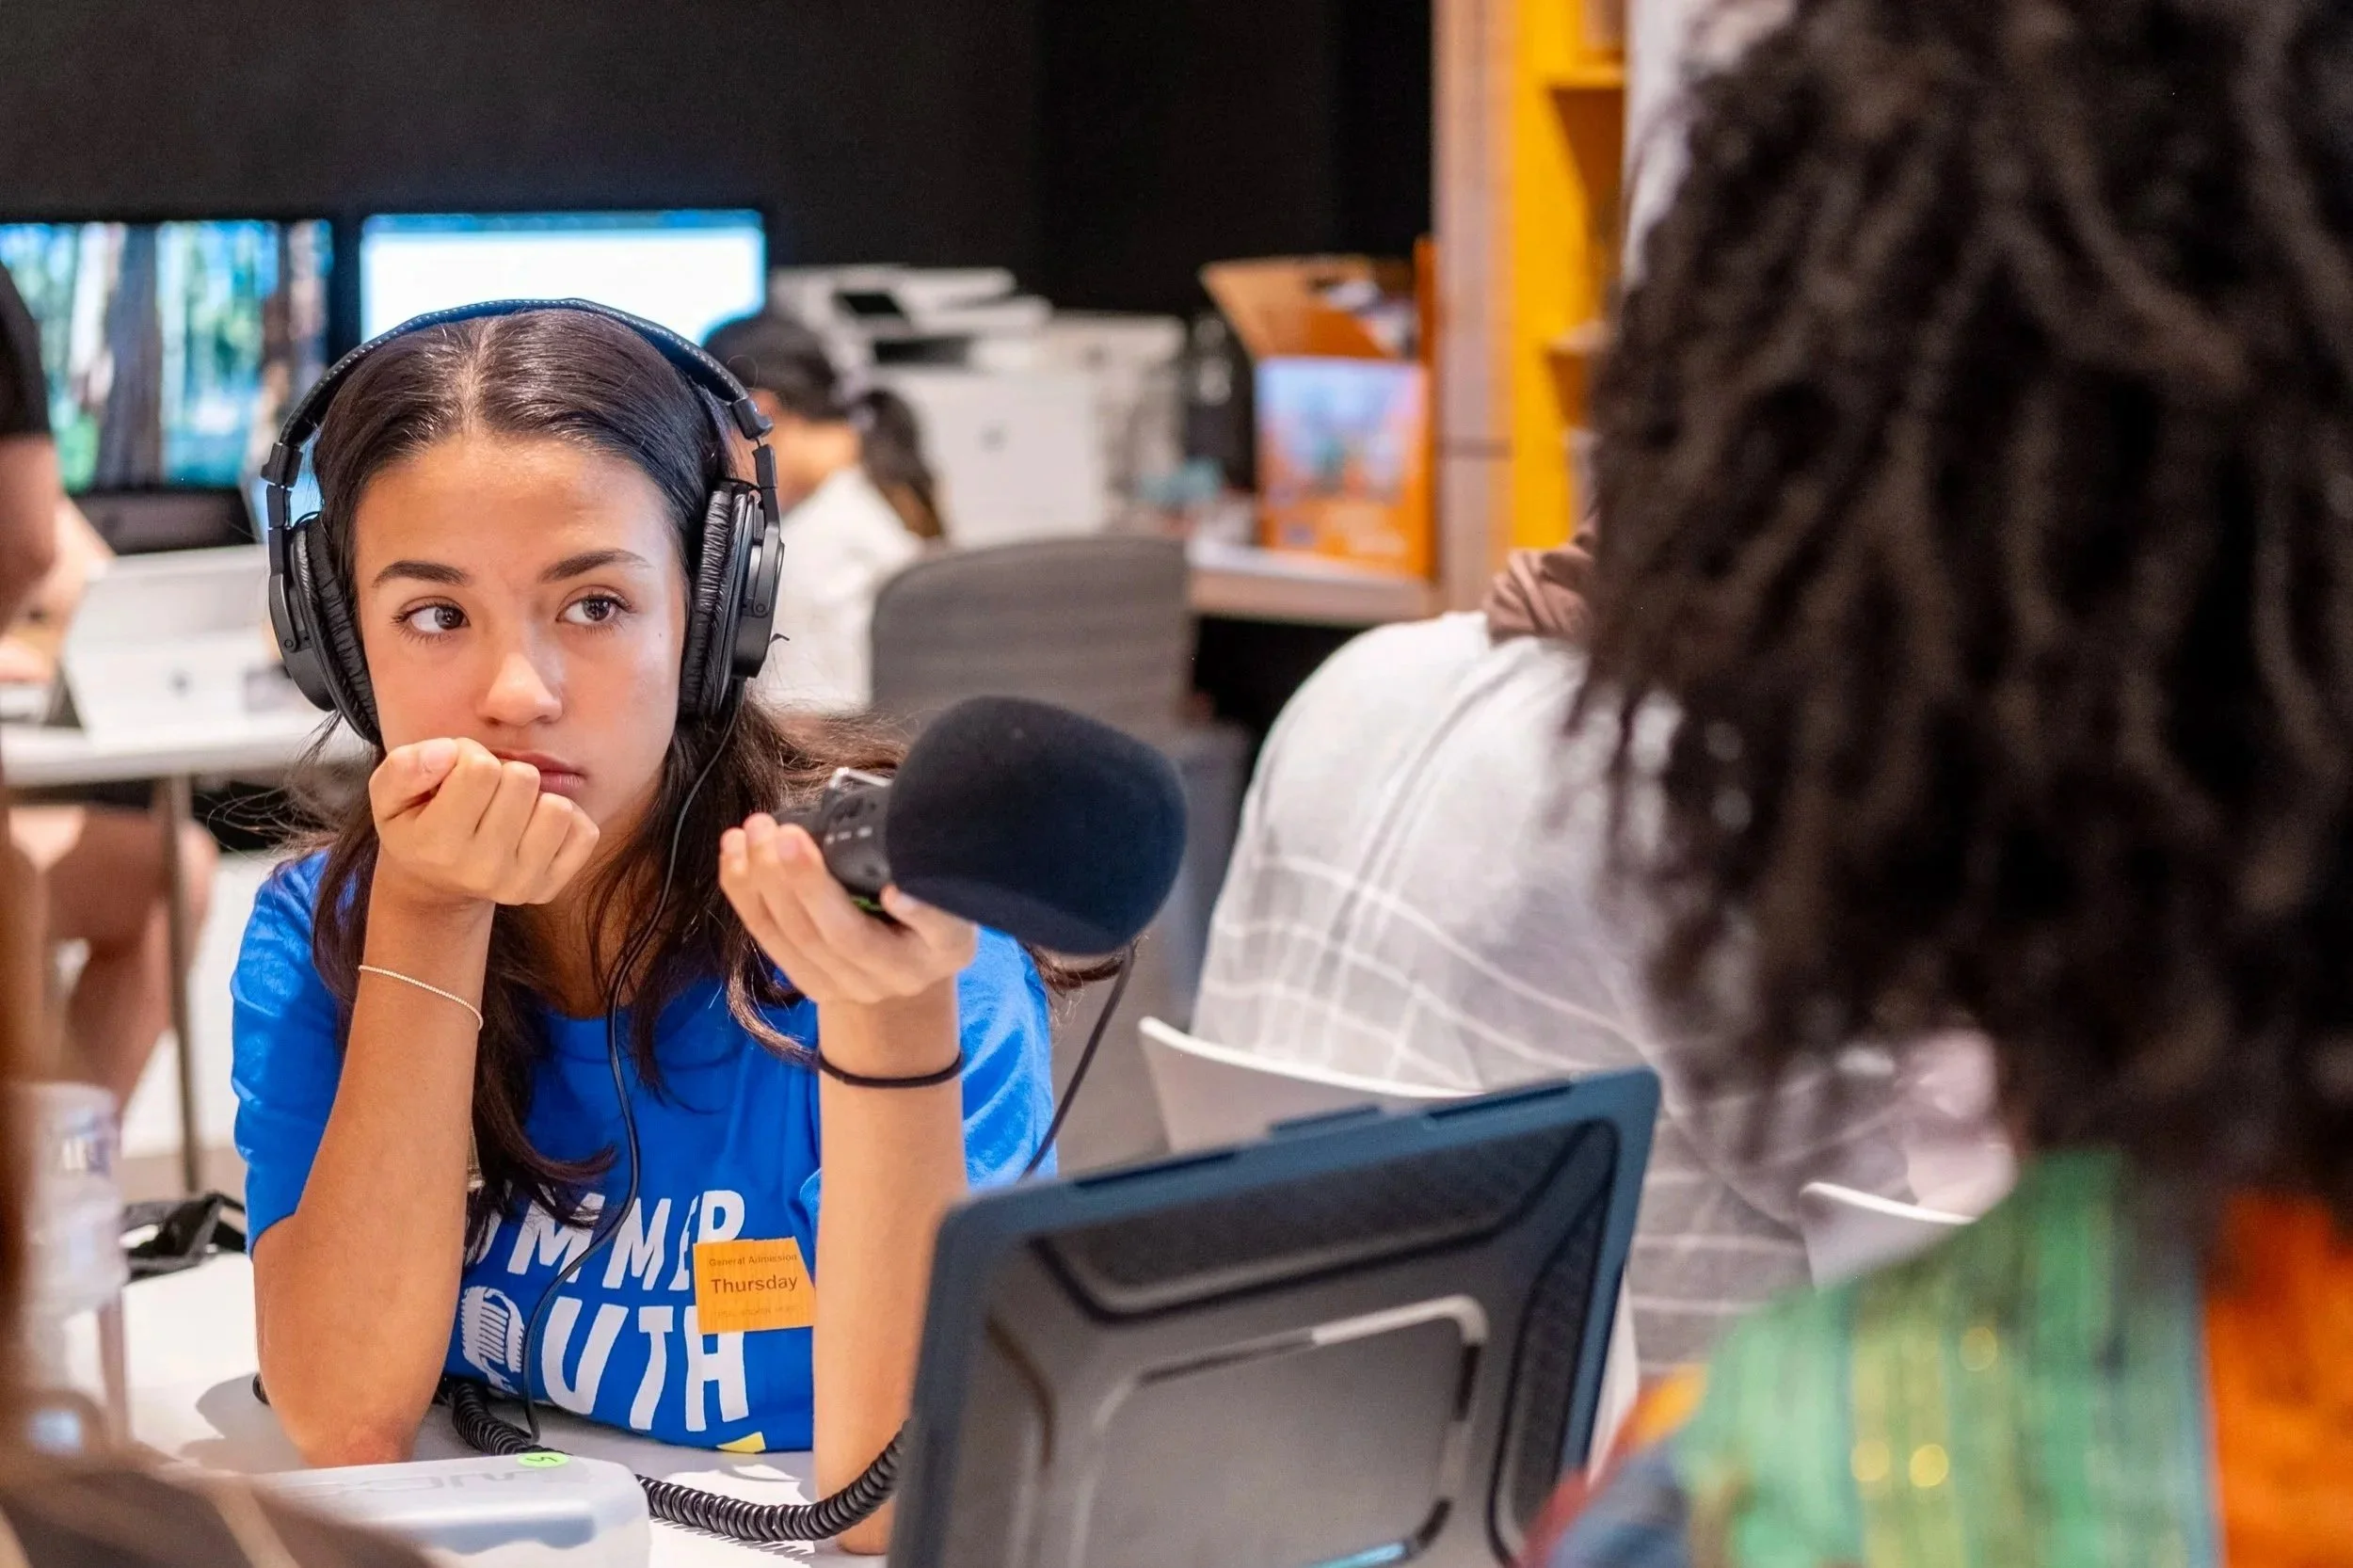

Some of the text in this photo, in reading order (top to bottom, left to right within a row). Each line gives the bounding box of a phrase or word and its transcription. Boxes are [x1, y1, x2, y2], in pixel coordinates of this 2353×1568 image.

[709, 1253, 797, 1267] General Admission
[711, 1273, 798, 1294] Thursday
